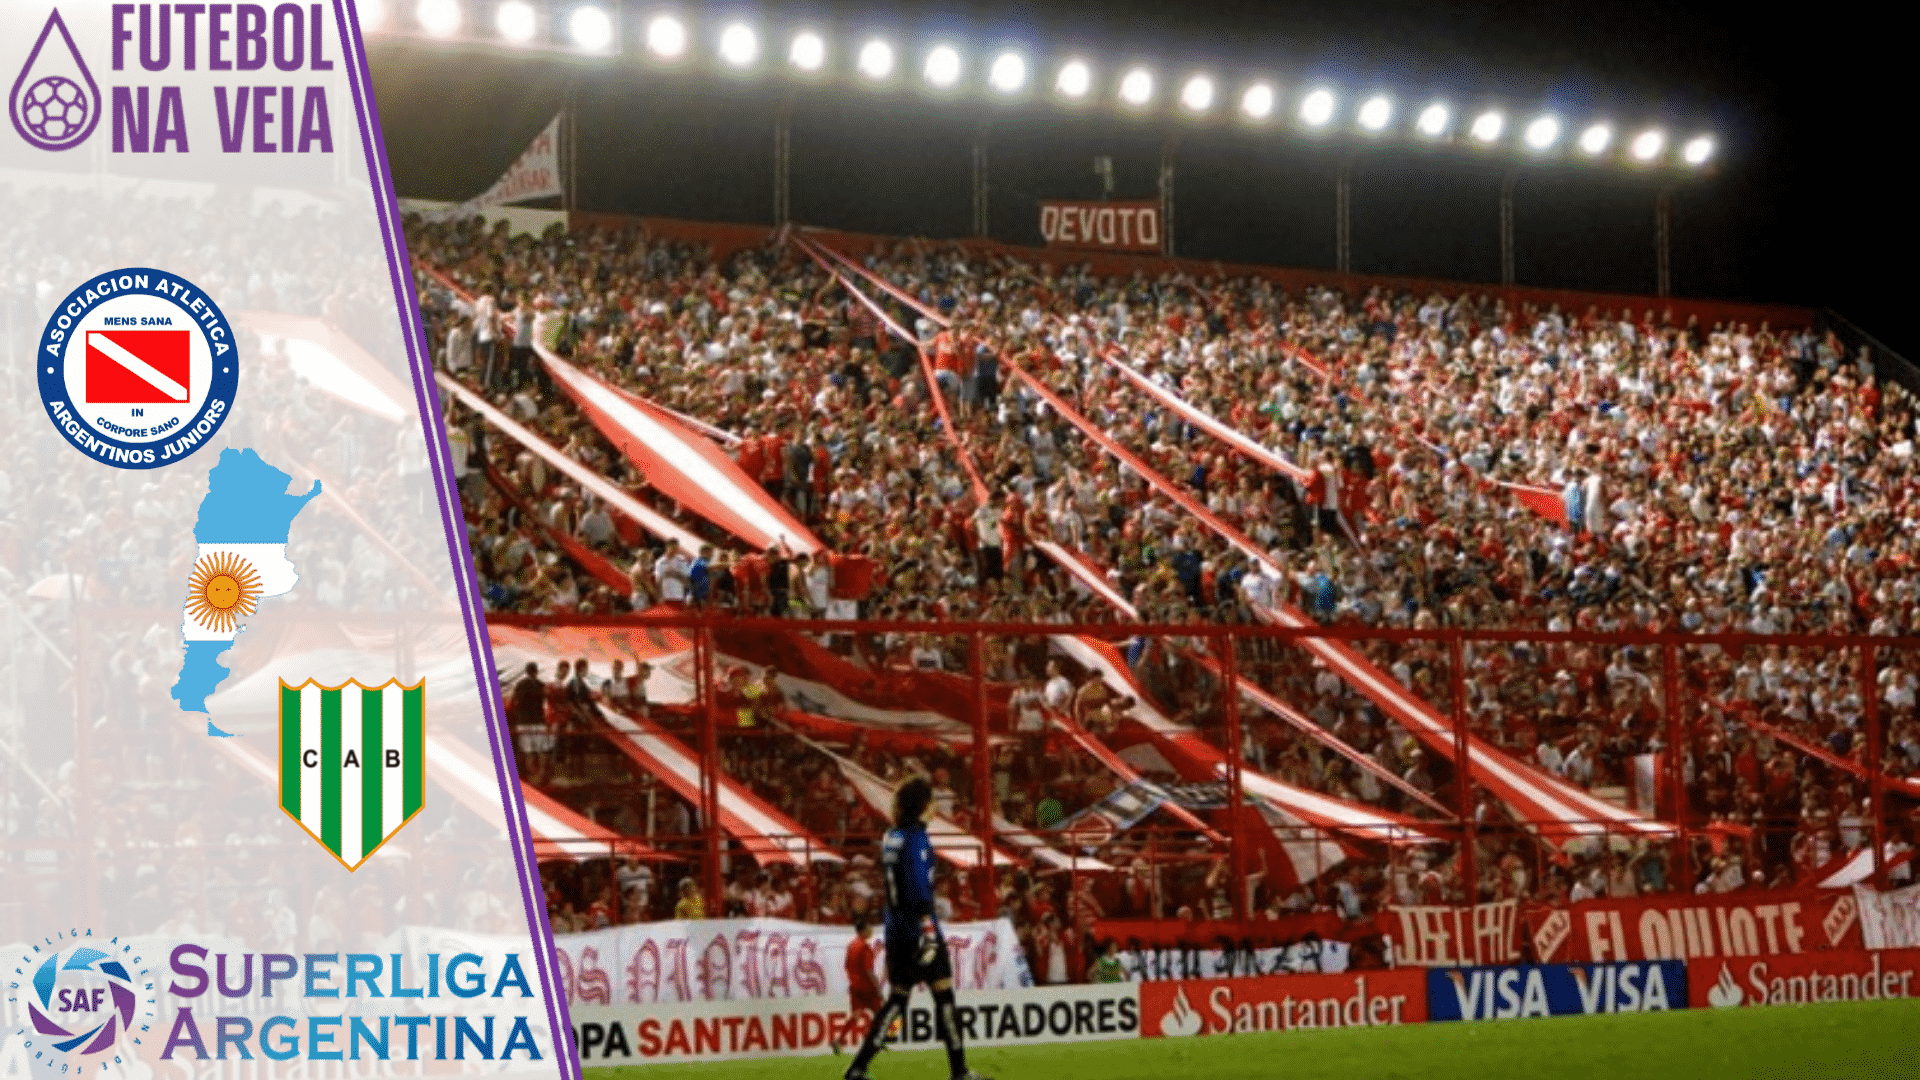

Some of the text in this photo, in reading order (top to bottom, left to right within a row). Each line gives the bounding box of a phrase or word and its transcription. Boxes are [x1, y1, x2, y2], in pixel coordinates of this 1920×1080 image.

[1041, 205, 1158, 244] DEVOTO
[1208, 974, 1406, 1034] Santander
[1447, 964, 1670, 1021] VISA VISA
[1747, 952, 1914, 1006] Santander
[882, 997, 1139, 1045] IBRTADORES
